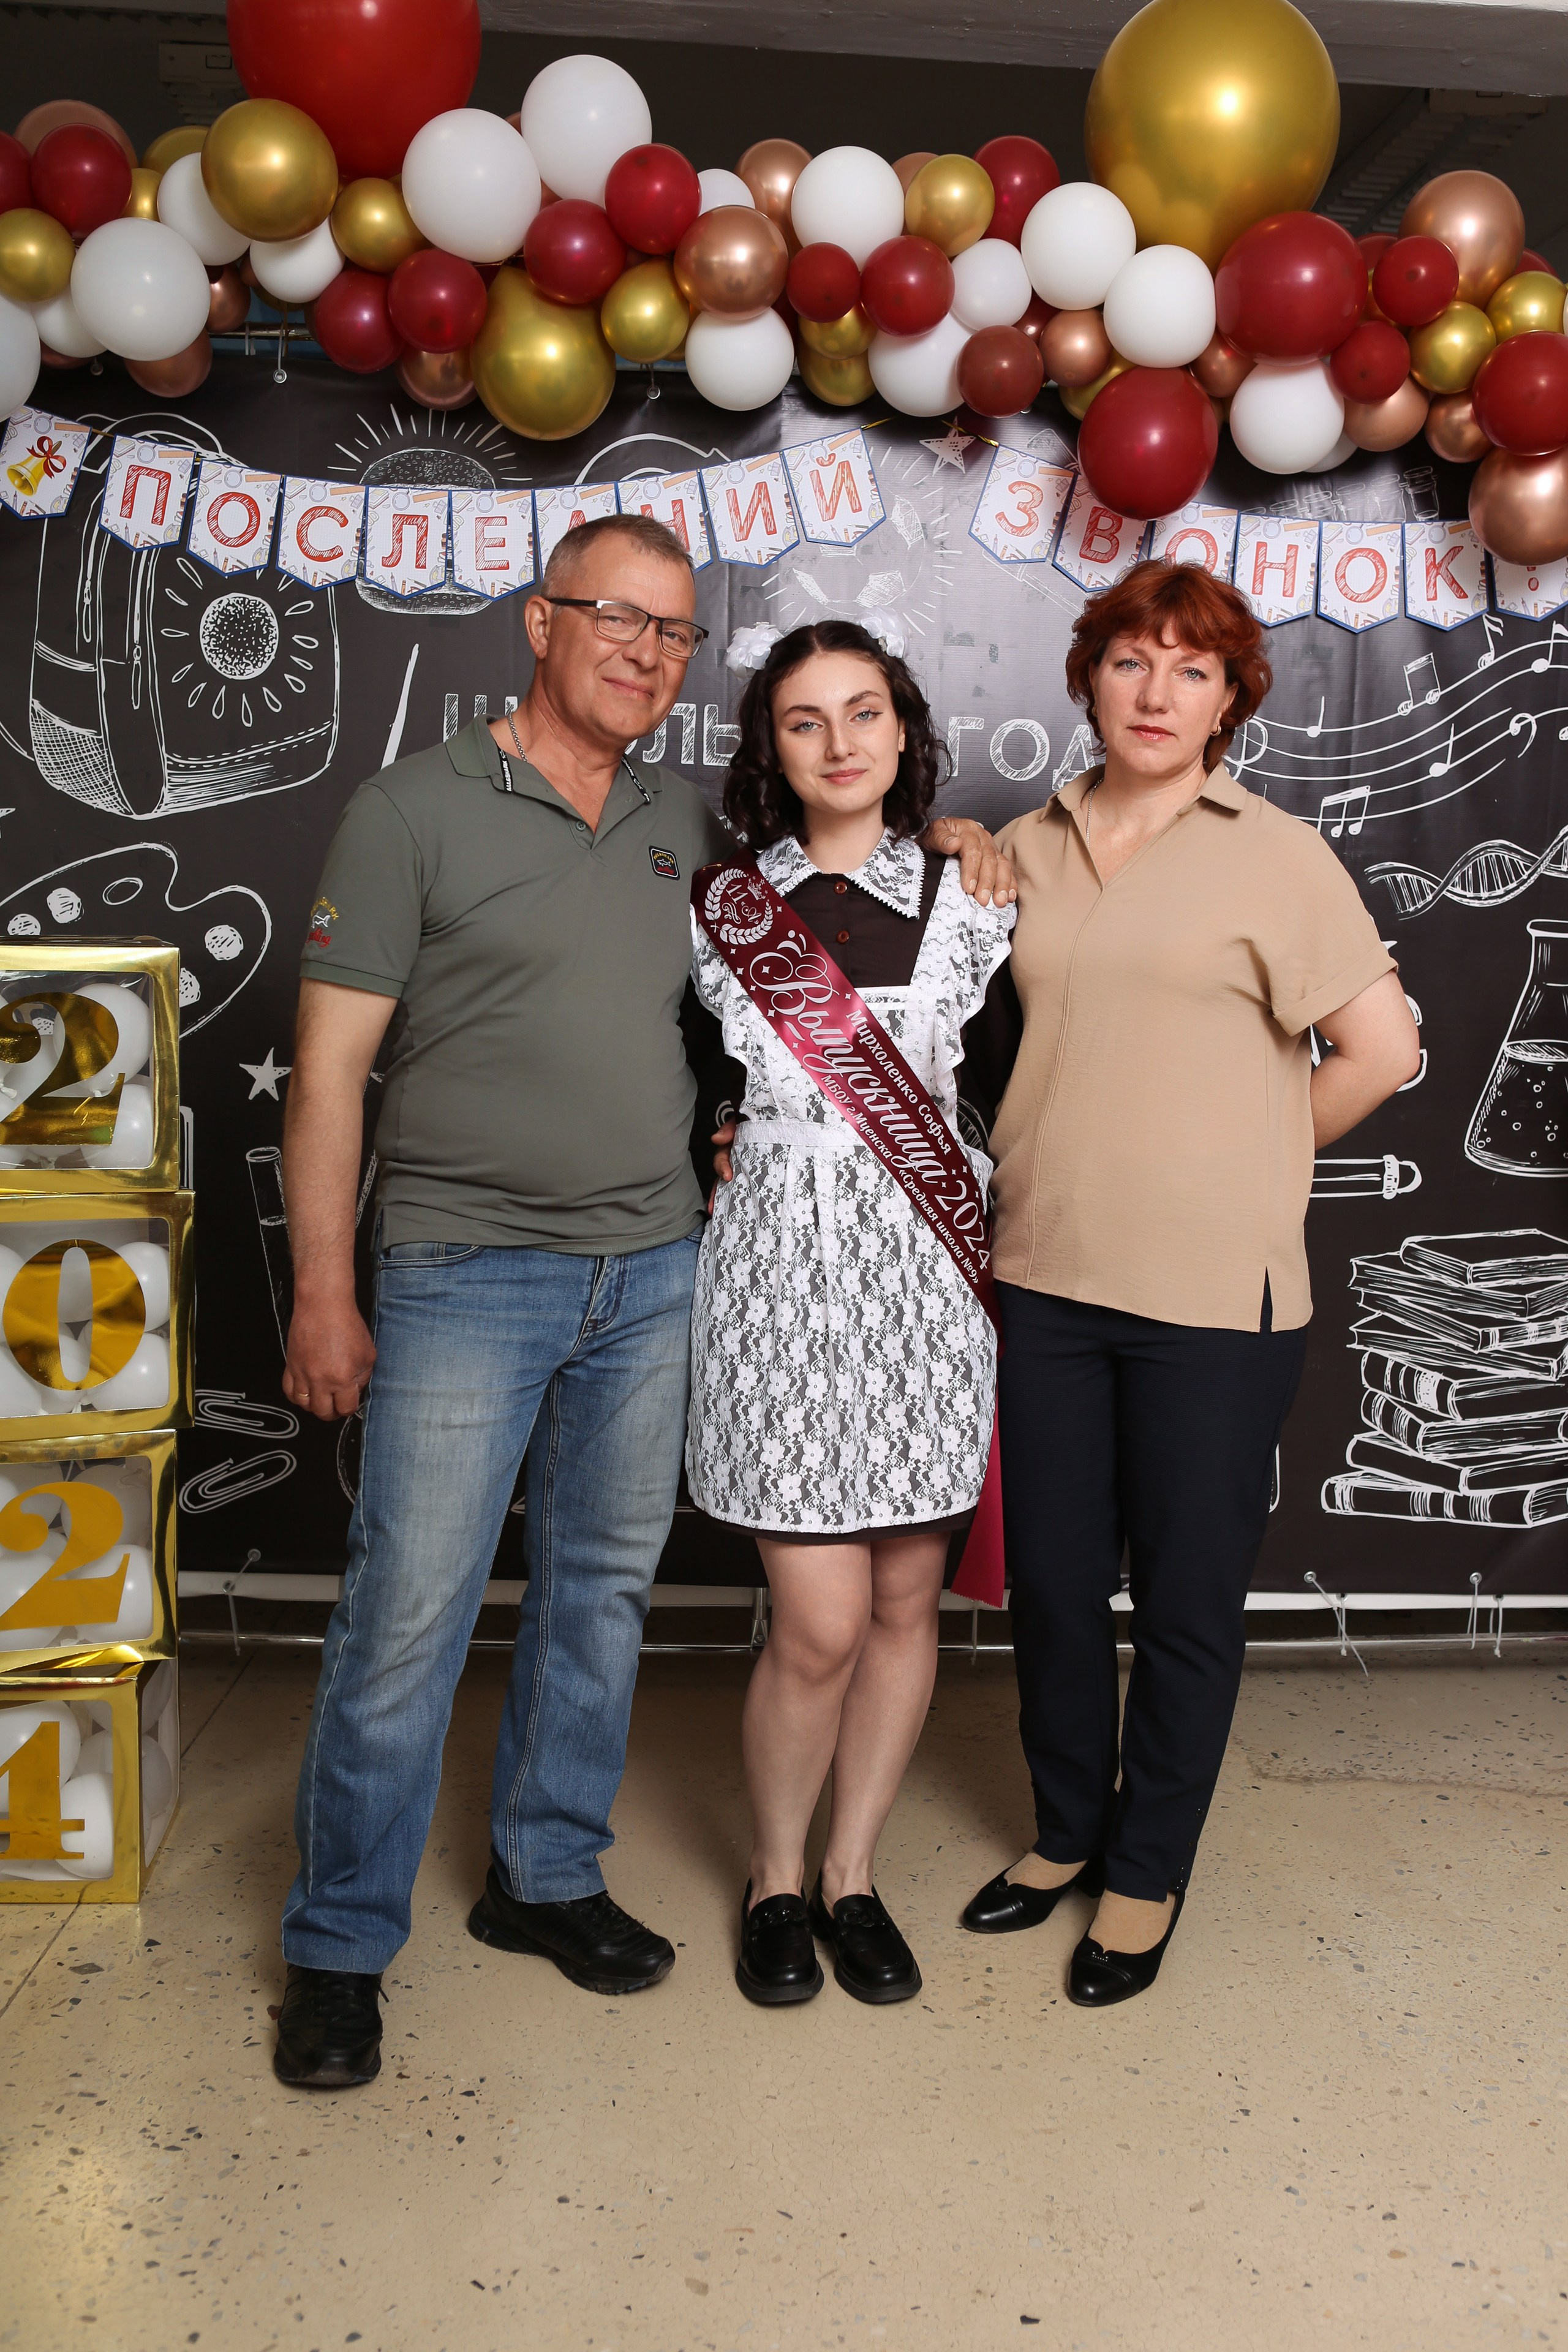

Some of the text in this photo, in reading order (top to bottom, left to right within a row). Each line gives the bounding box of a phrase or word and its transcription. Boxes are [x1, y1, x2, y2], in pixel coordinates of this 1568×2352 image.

[121, 453, 862, 570] ПОСЛЕНИЙ
[946, 716, 1096, 791] ГОД
[725, 884, 748, 904] 11
[750, 940, 990, 1270] Выпускница 2024
[846, 1007, 951, 1155] Мирхоленко Софья
[821, 1074, 853, 1105] МБОУ
[898, 1168, 938, 1222] «Средняя
[936, 1221, 964, 1259] школа
[960, 1257, 979, 1284] №9»
